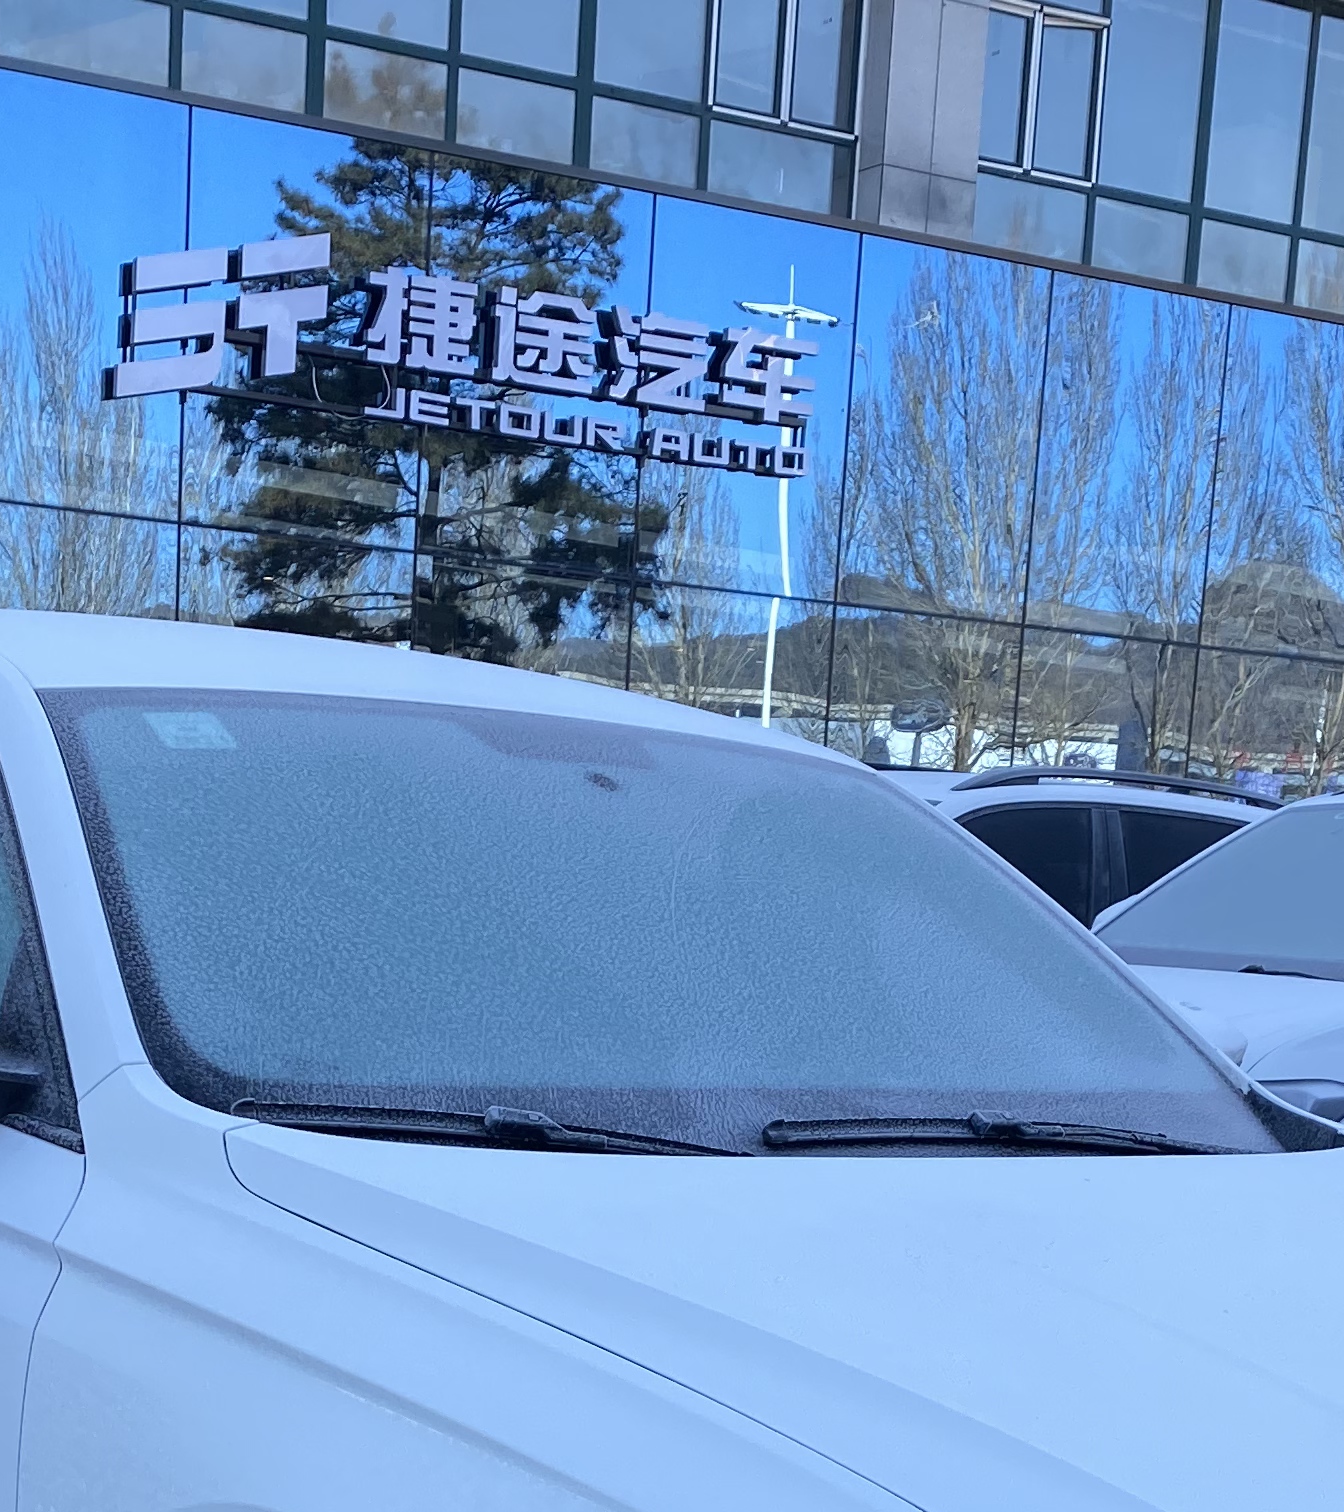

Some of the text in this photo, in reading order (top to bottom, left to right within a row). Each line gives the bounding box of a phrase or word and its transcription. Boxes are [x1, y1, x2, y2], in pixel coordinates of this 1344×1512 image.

[362, 265, 820, 424] 捷途汽车
[364, 386, 807, 478] JETOUR AUTO
